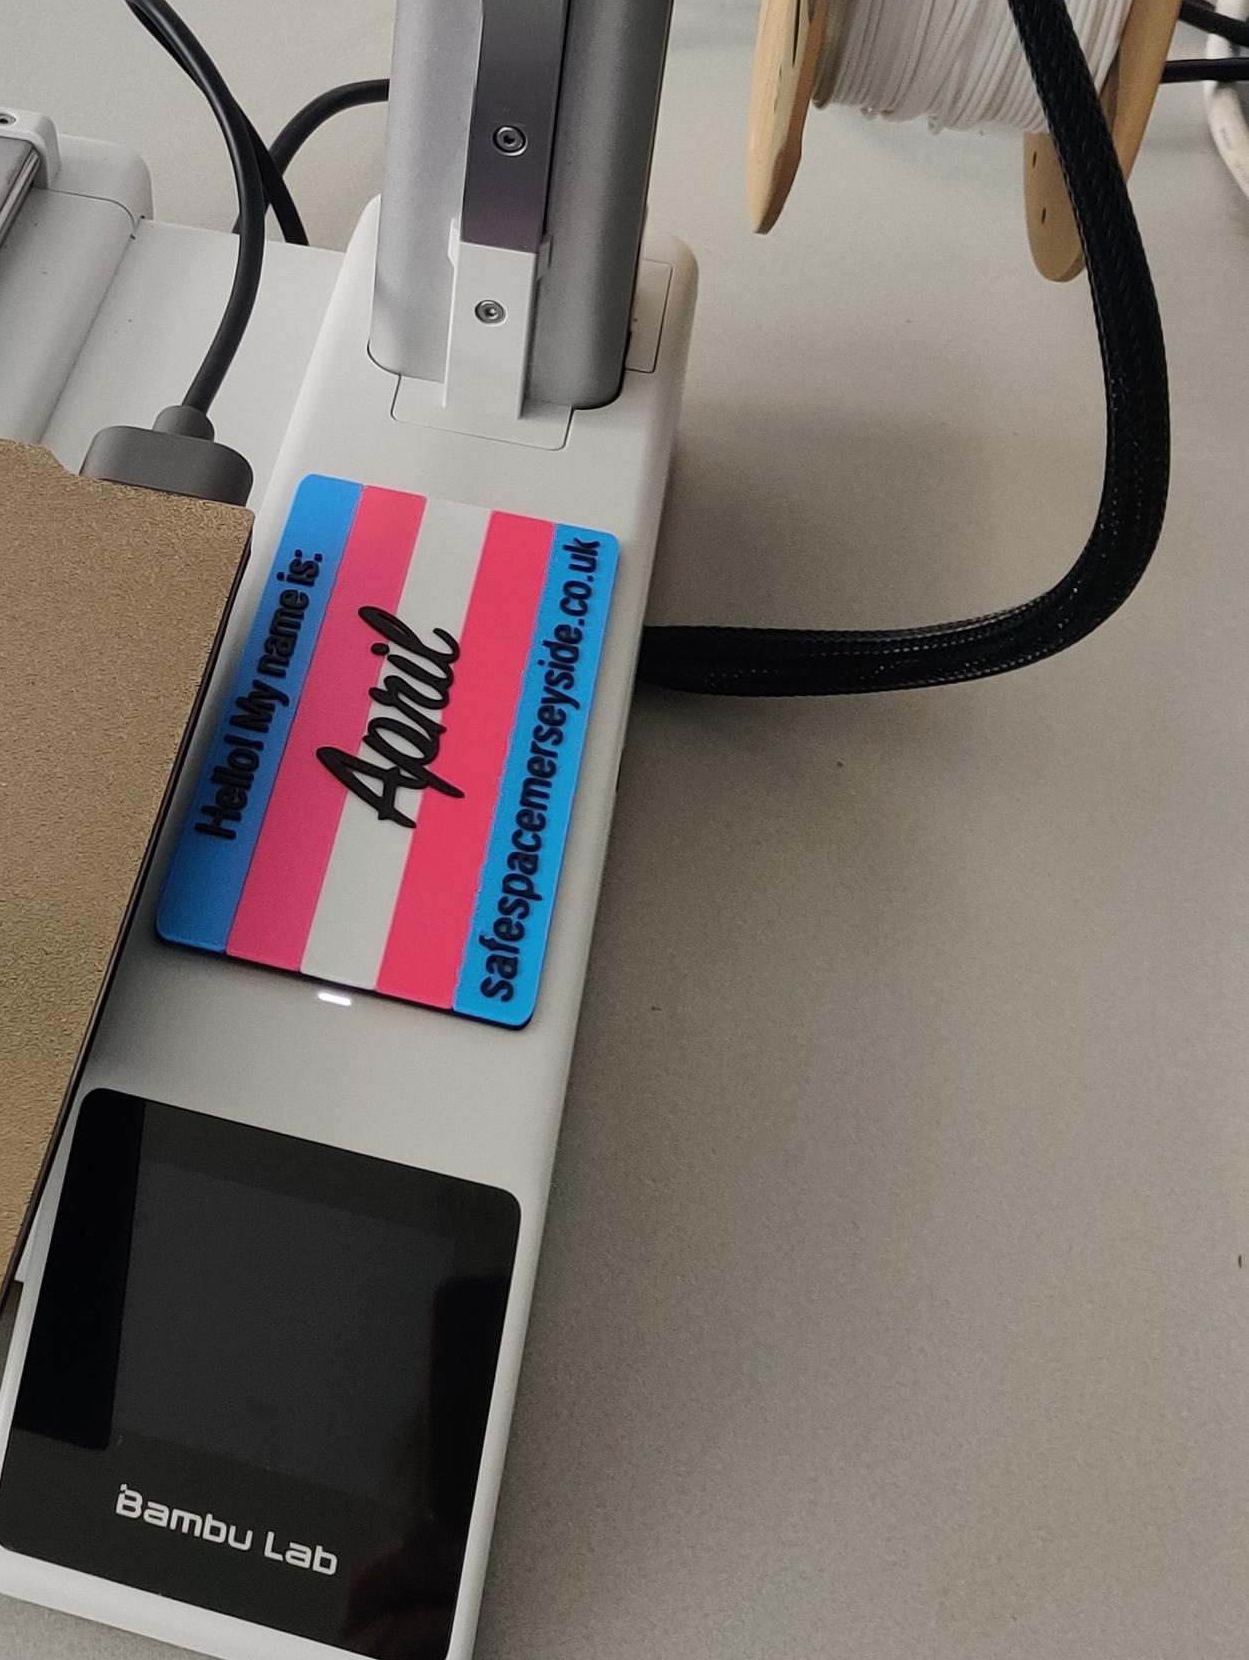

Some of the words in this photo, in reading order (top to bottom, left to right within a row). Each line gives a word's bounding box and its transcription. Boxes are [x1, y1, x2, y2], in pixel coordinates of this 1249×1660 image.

[276, 548, 324, 588] is:
[258, 588, 310, 679] name
[229, 678, 291, 735] My
[316, 605, 466, 830] April
[194, 726, 265, 840] Hello!
[480, 536, 602, 1004] safespacemerseyside.co.uk
[116, 1483, 254, 1552] Bambu
[263, 1530, 339, 1577] Lab
